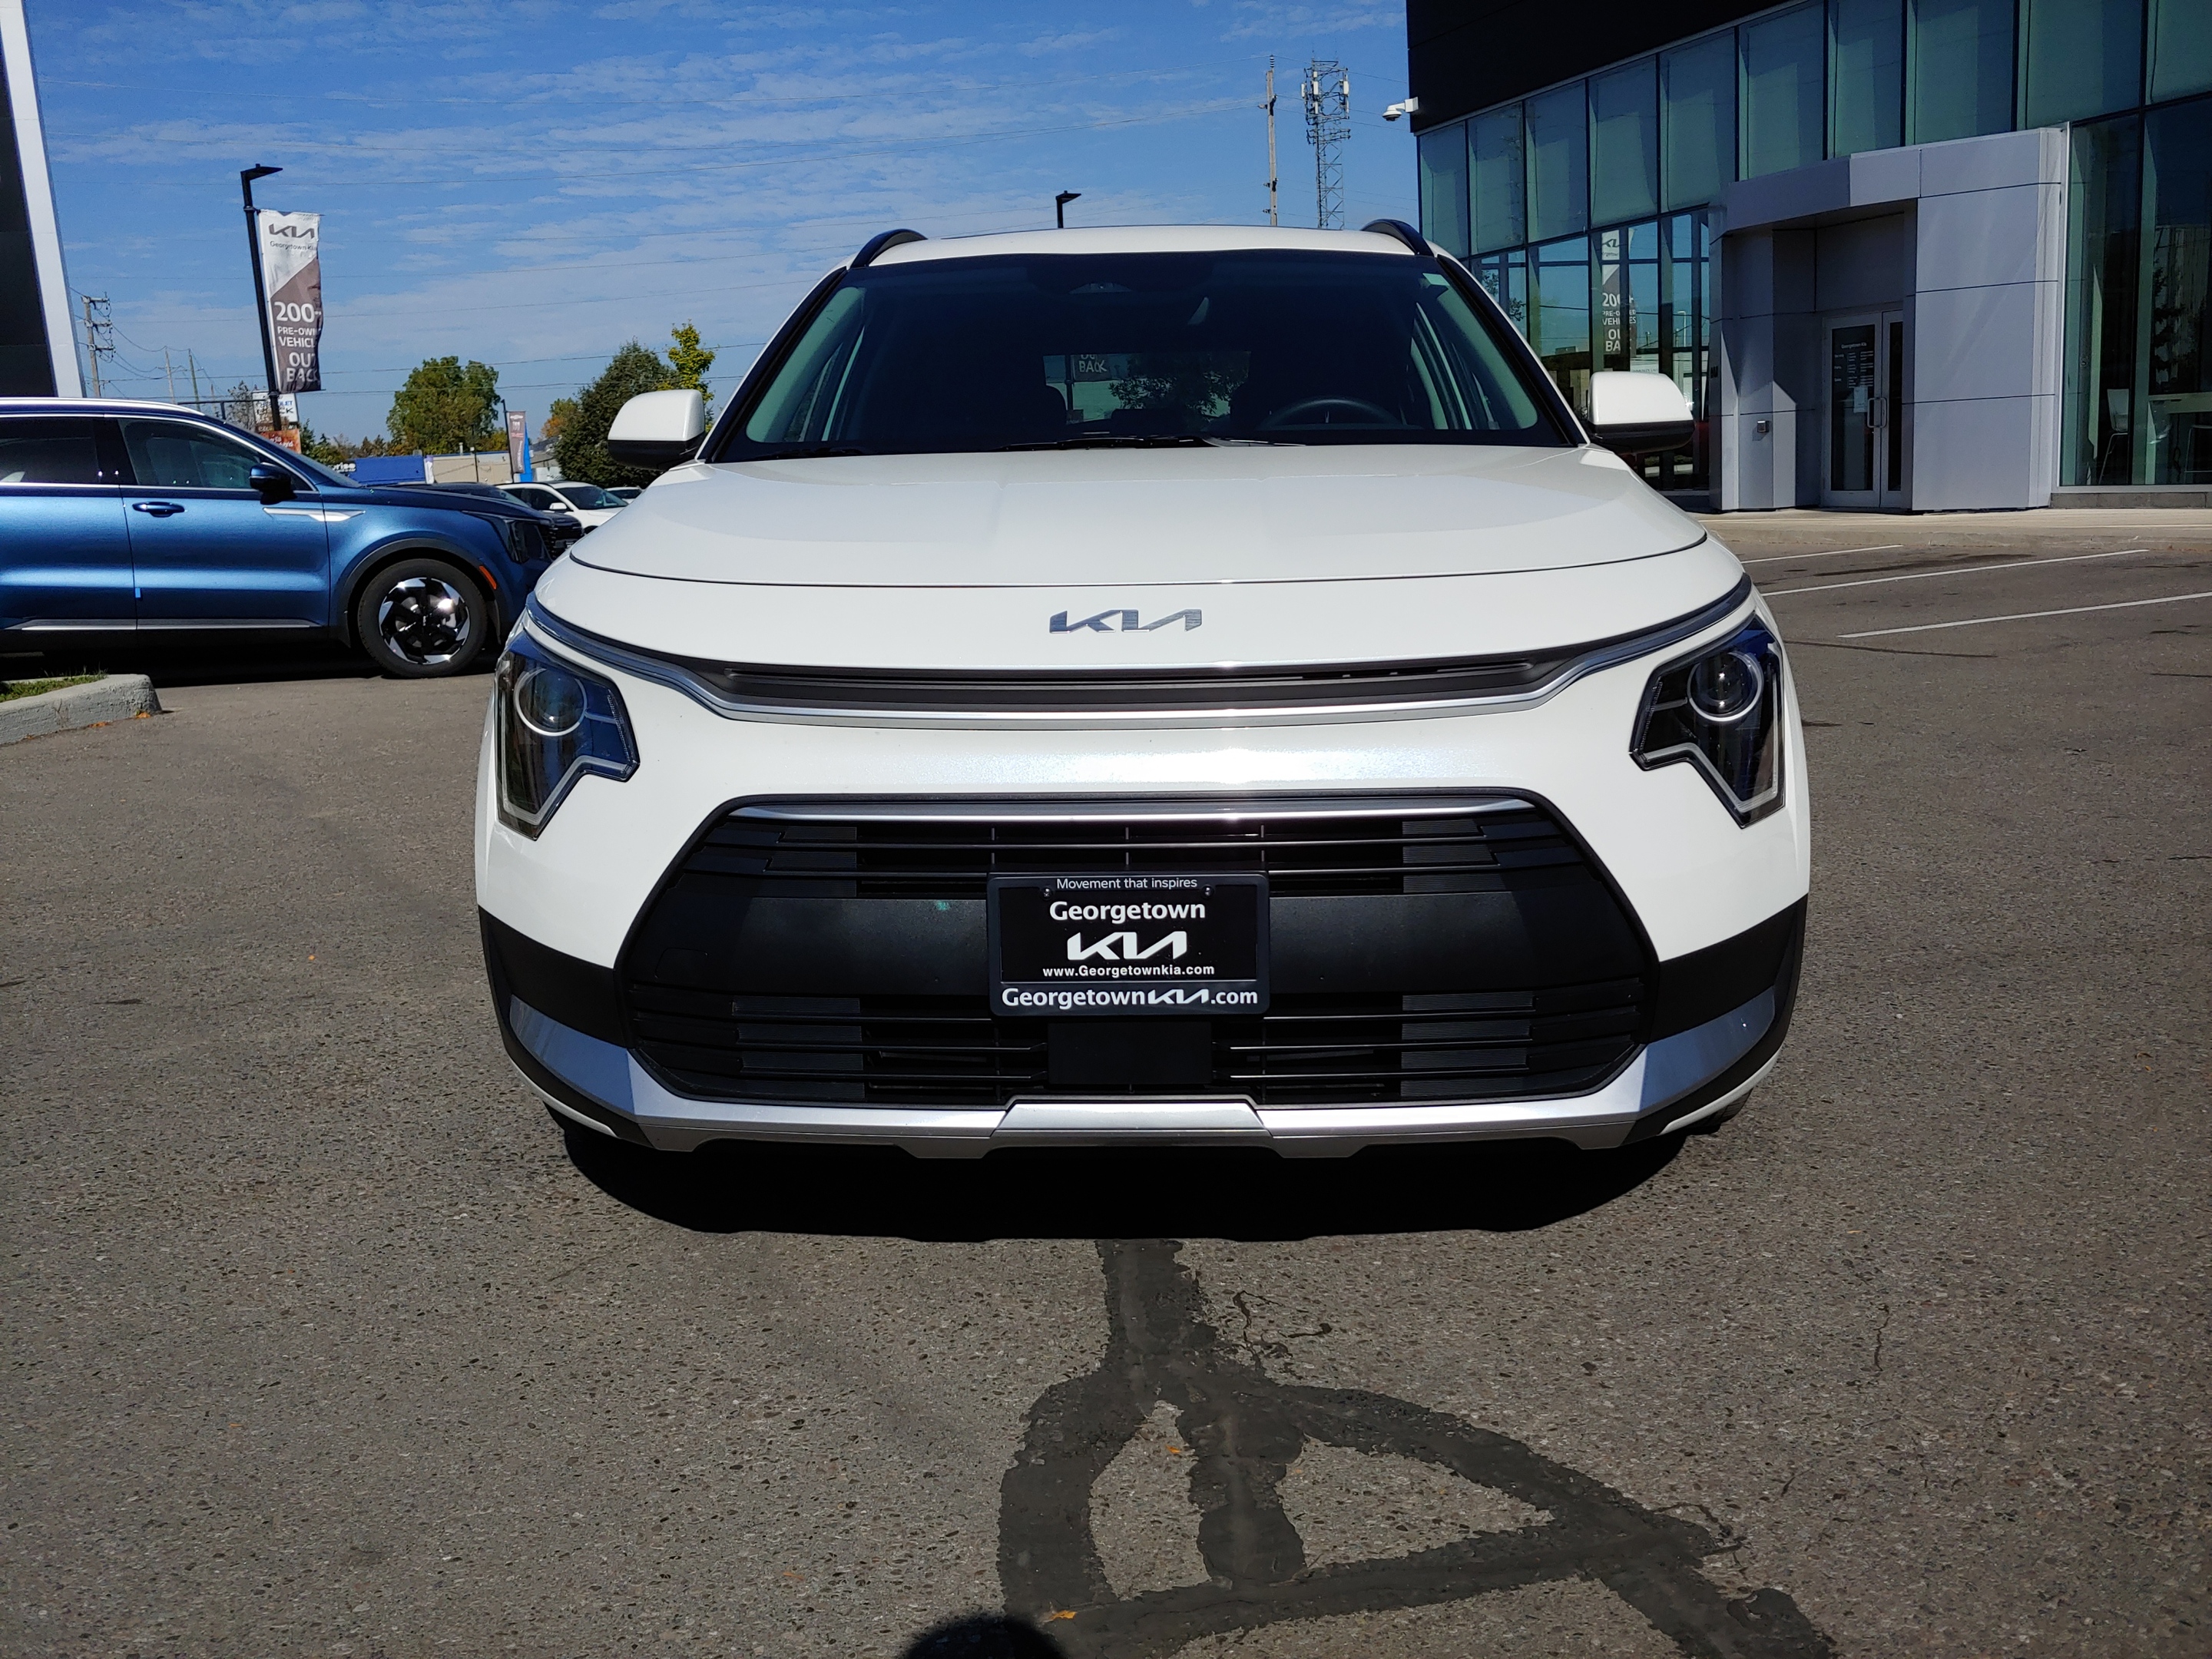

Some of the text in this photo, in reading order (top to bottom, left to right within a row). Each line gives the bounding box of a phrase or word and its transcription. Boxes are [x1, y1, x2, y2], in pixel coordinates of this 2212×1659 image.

[269, 224, 315, 239] KIA
[1049, 609, 1203, 634] KIA
[1057, 878, 1197, 889] Movement that inspires
[1049, 901, 1206, 924] Georgetown
[1067, 931, 1187, 960] KIA
[1042, 965, 1215, 978] www.Georgetownkia.com
